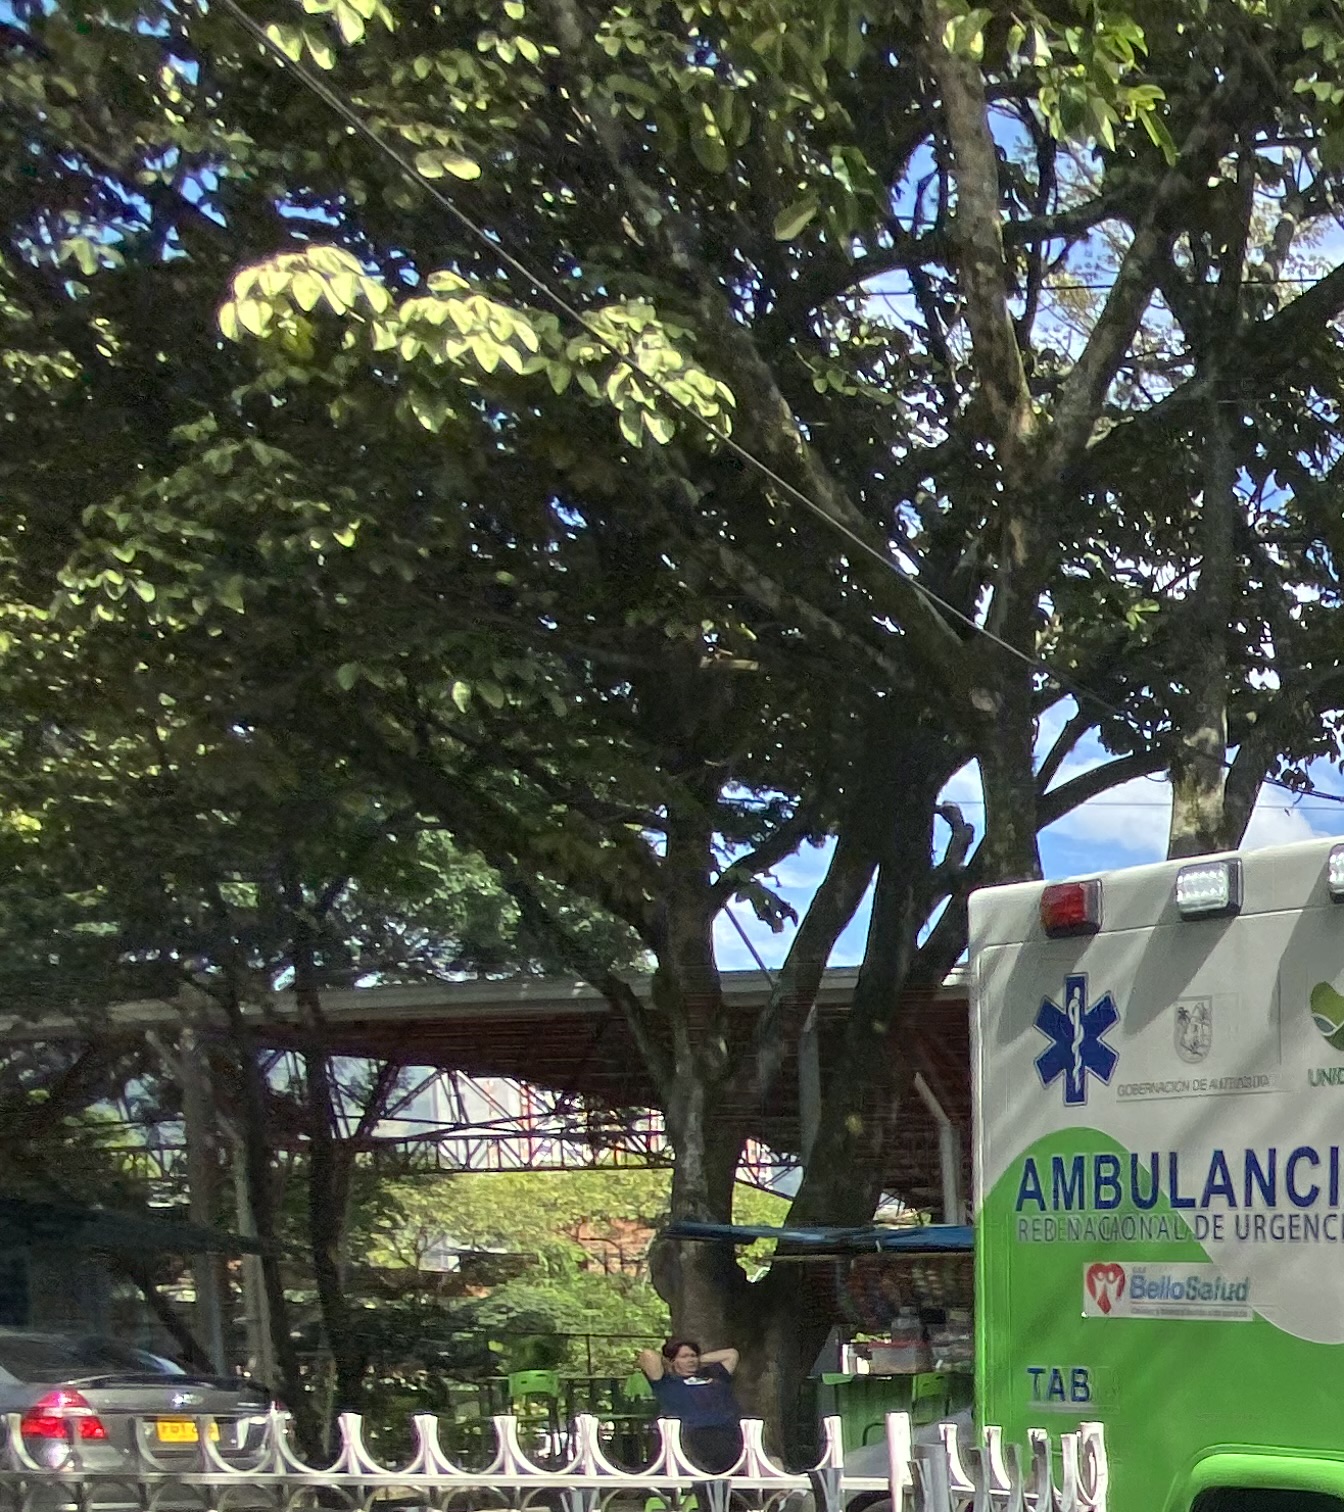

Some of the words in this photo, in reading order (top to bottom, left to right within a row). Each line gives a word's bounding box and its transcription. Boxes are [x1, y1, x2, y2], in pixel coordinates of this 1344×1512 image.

[1194, 1214, 1224, 1241] DE
[1130, 1275, 1249, 1302] BelloSalud
[1026, 1367, 1090, 1402] TAB
